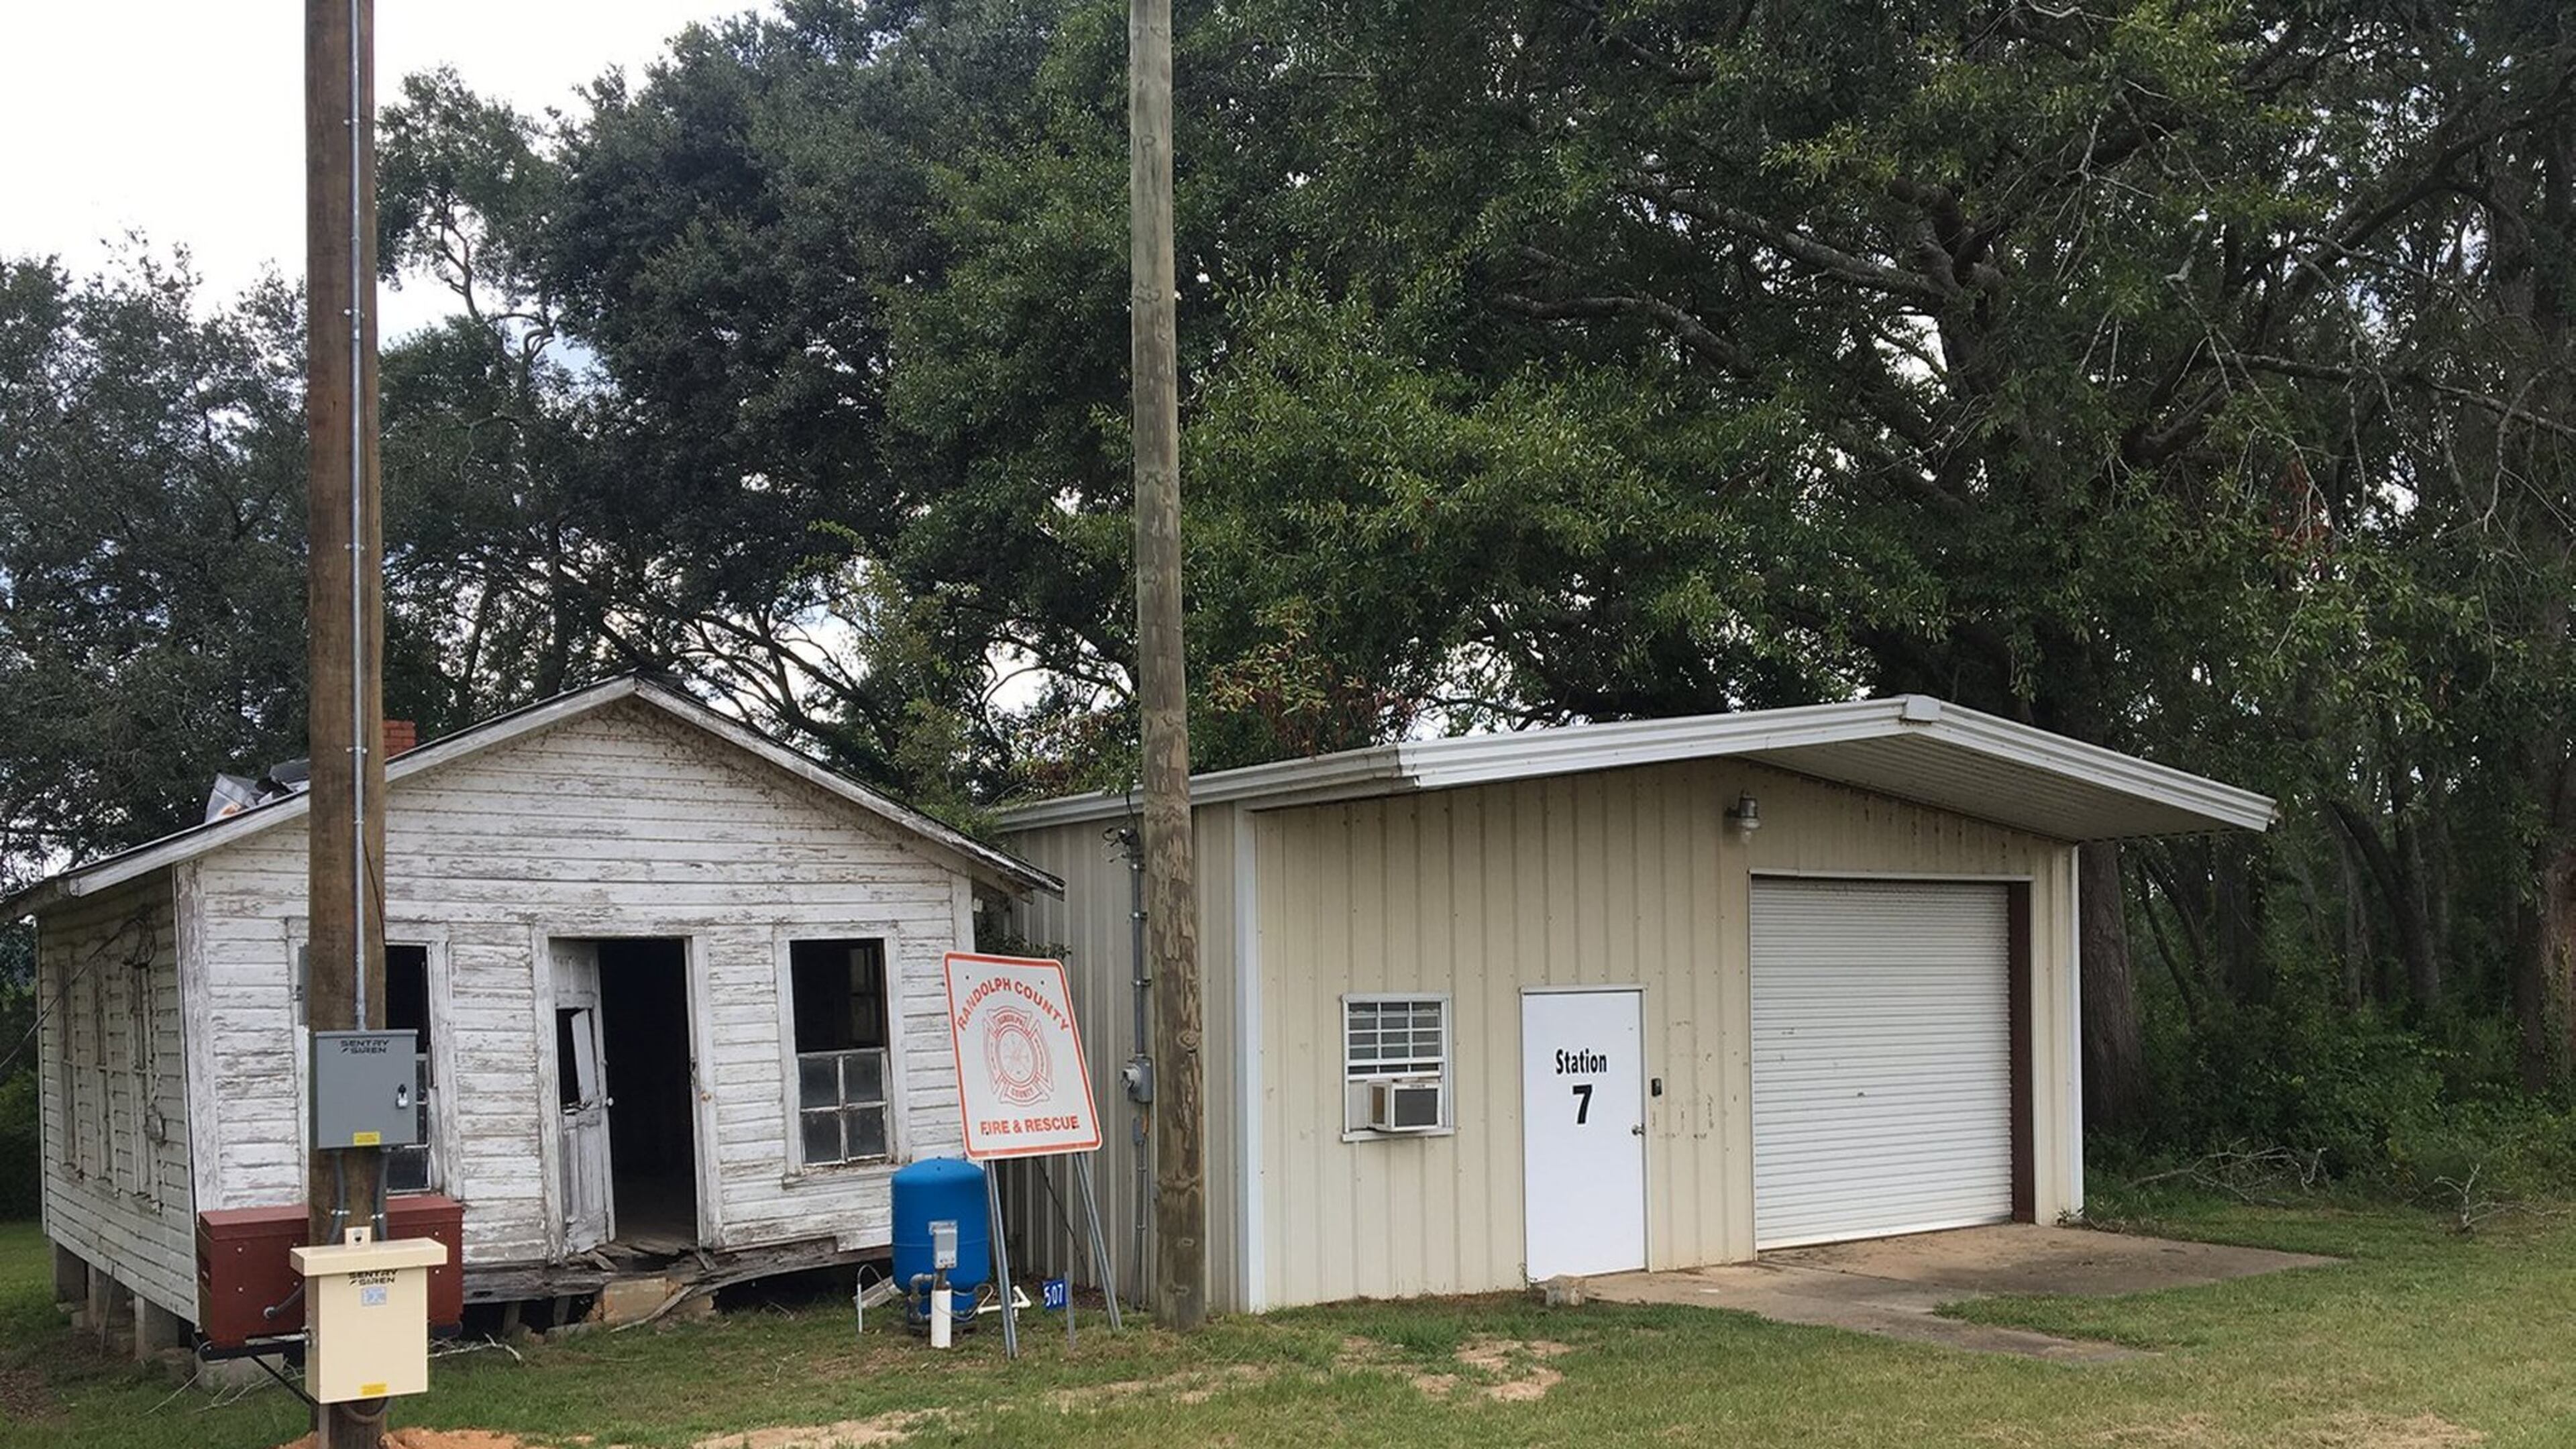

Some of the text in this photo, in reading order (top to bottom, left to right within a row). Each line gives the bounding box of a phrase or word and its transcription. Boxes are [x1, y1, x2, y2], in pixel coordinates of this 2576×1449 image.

[957, 977, 1069, 1031] RANDOLPH COUNTY
[1556, 1048, 1607, 1075] Station
[1572, 1084, 1593, 1125] 7
[980, 1116, 1080, 1135] FIRE & RESCUE
[1044, 1283, 1063, 1307] 507
